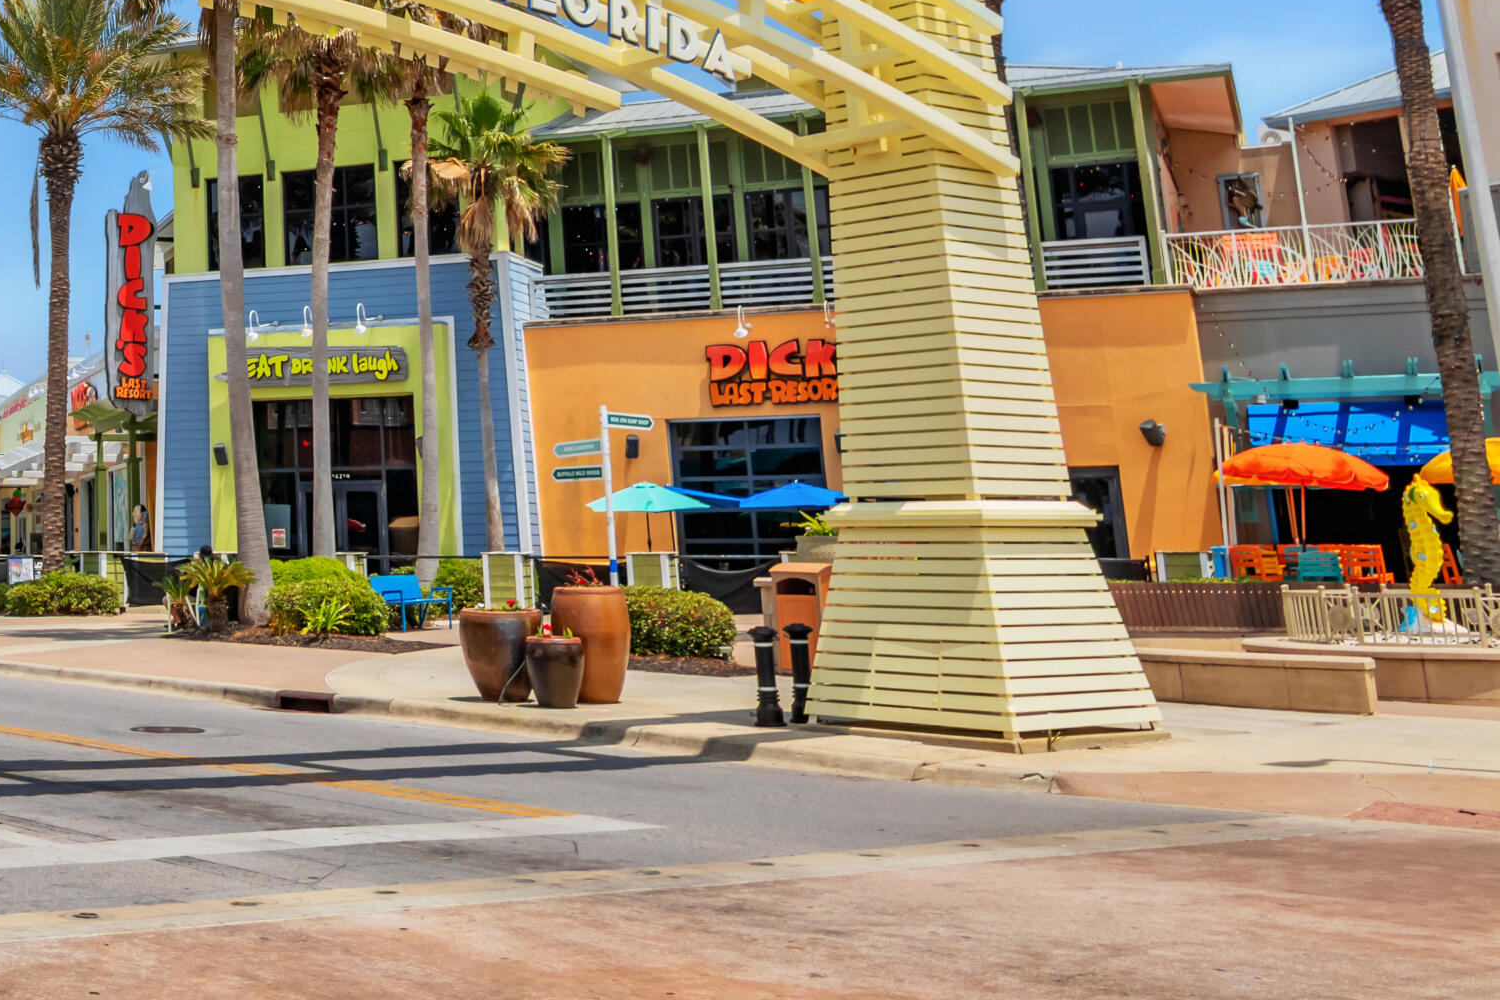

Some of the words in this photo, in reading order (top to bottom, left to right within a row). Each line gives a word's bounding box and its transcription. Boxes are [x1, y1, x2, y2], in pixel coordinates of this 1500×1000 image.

[116, 213, 152, 377] DICK'S
[246, 353, 289, 380] EAT
[290, 357, 349, 375] DRNK
[352, 350, 399, 380] laugh
[705, 338, 837, 382] DICK
[116, 386, 153, 400] RESORT
[121, 376, 147, 389] LAST
[709, 381, 767, 407] LAST
[767, 378, 838, 404] RESOR
